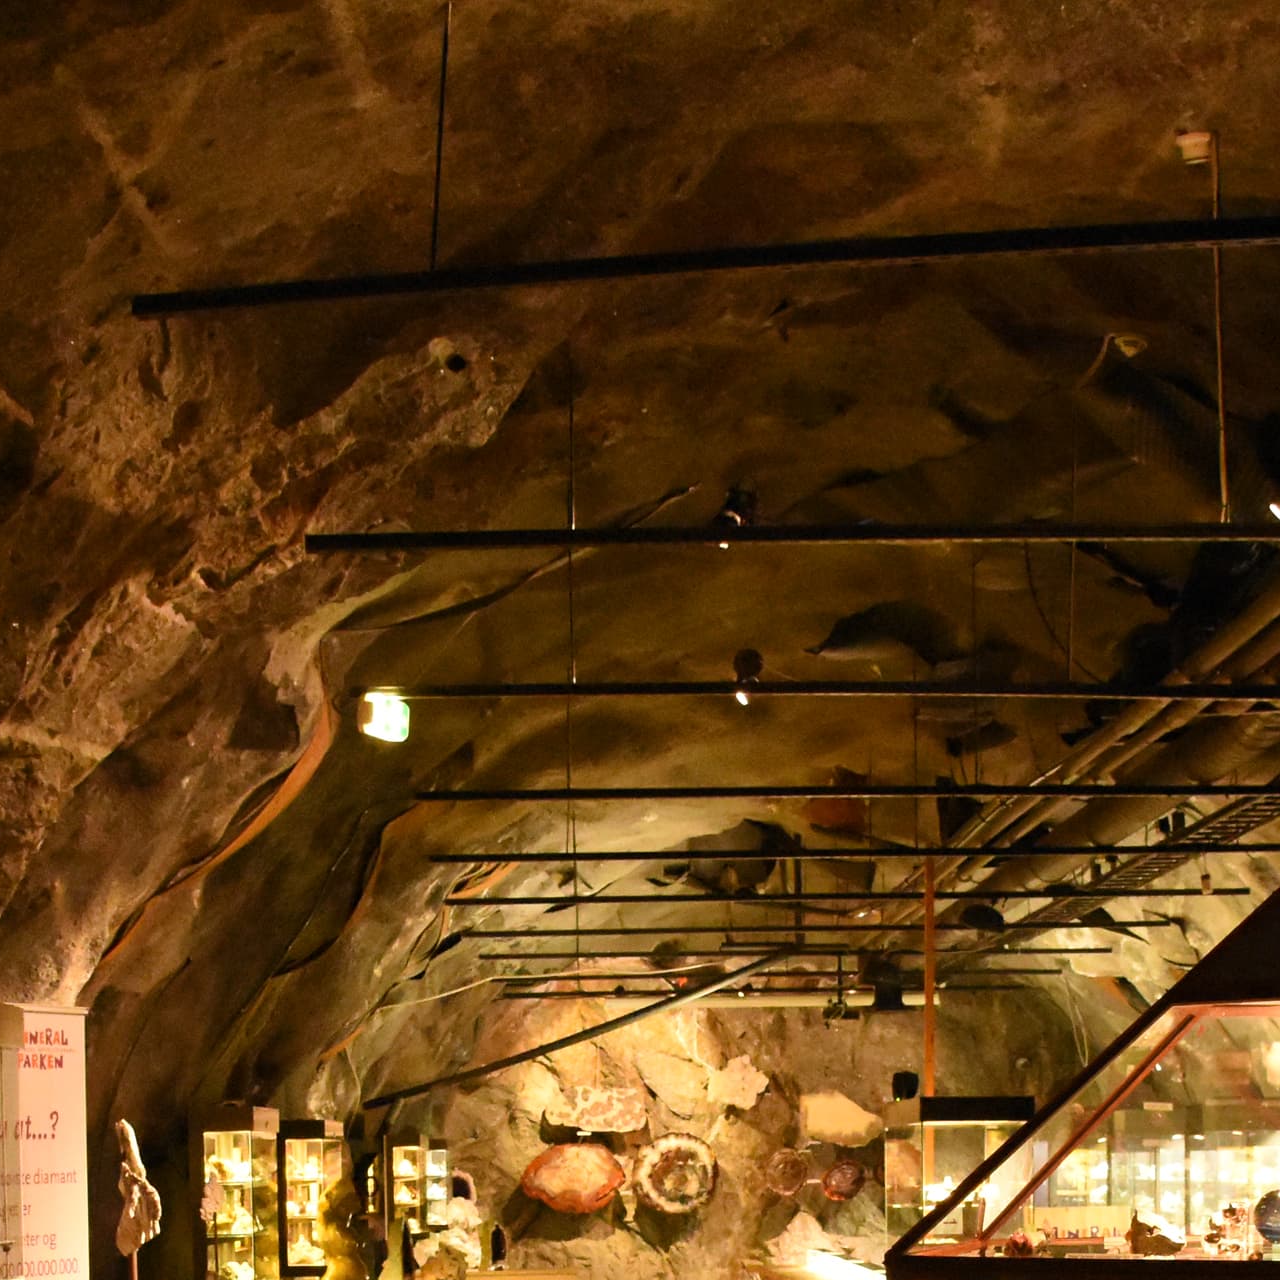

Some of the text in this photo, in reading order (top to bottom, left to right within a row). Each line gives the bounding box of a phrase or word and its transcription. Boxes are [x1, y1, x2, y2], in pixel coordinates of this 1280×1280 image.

[17, 1053, 64, 1070] PARKEN
[33, 1168, 78, 1186] diamant
[42, 1233, 57, 1249] og
